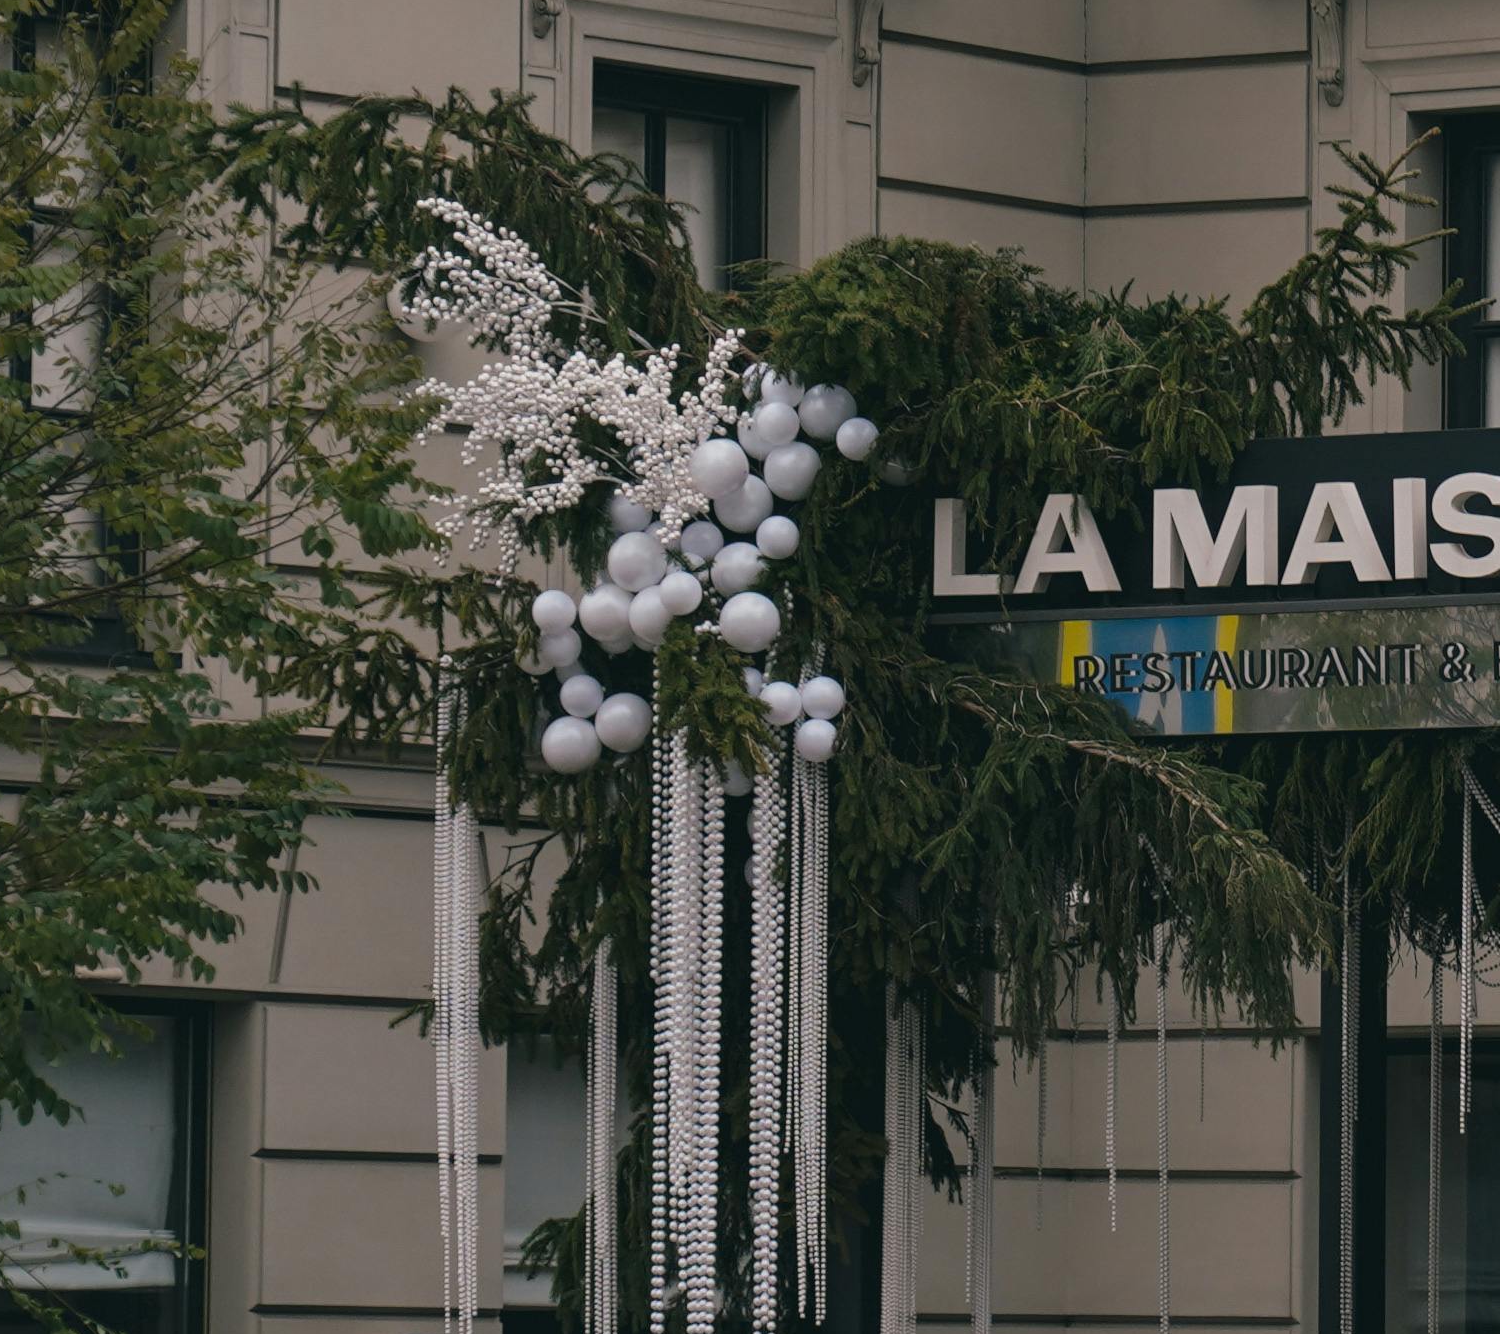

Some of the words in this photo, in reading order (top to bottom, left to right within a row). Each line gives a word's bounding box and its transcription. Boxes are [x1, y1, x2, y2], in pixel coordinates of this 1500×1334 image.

[933, 493, 1122, 596] LA
[1073, 642, 1424, 694] RESTAURANT
[1441, 640, 1477, 684] &
